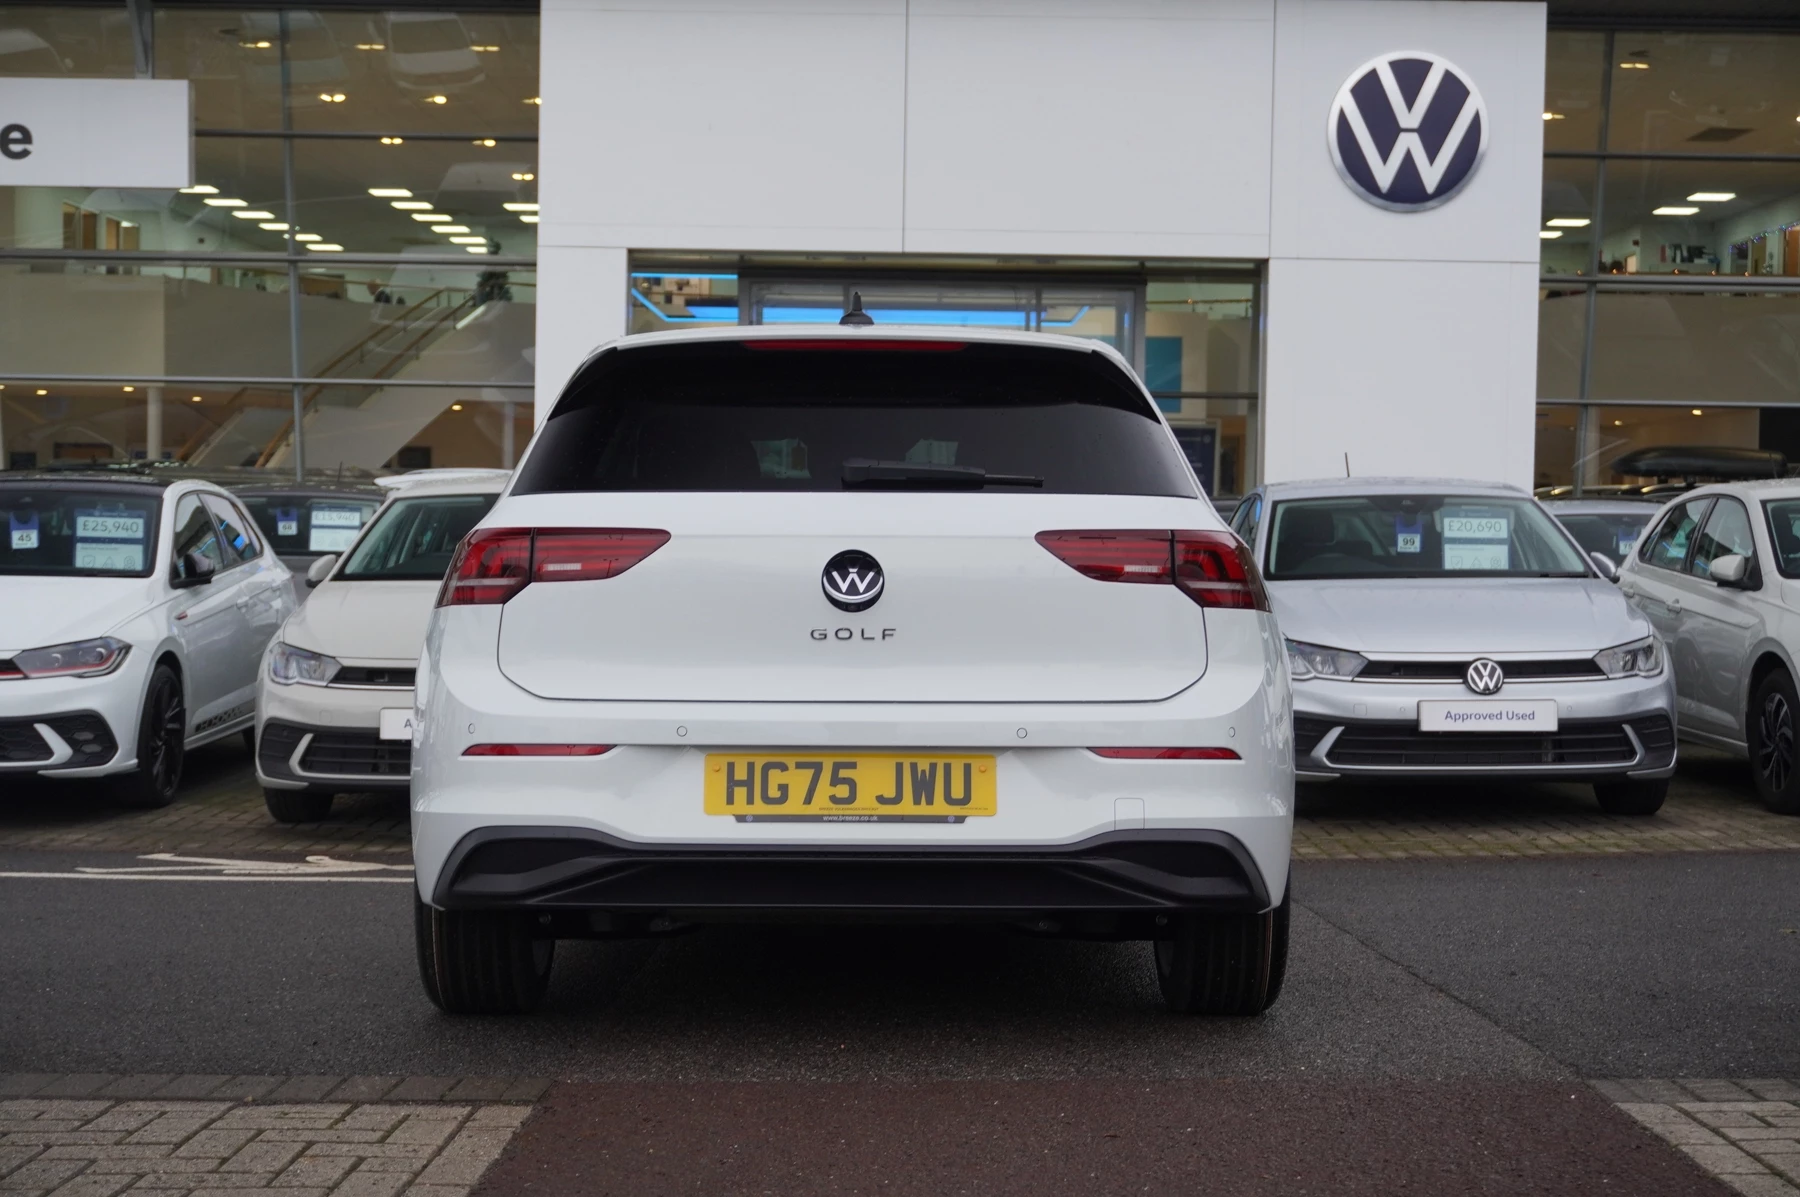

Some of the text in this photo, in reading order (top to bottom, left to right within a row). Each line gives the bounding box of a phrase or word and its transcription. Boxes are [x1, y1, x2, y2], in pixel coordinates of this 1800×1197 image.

[82, 520, 139, 533] £25,940
[1448, 520, 1502, 533] £20,690
[18, 534, 32, 543] 45
[1402, 537, 1416, 547] 99
[810, 627, 897, 641] GOLF
[1444, 710, 1536, 723] Approved Used
[725, 761, 972, 807] HG75 JWU
